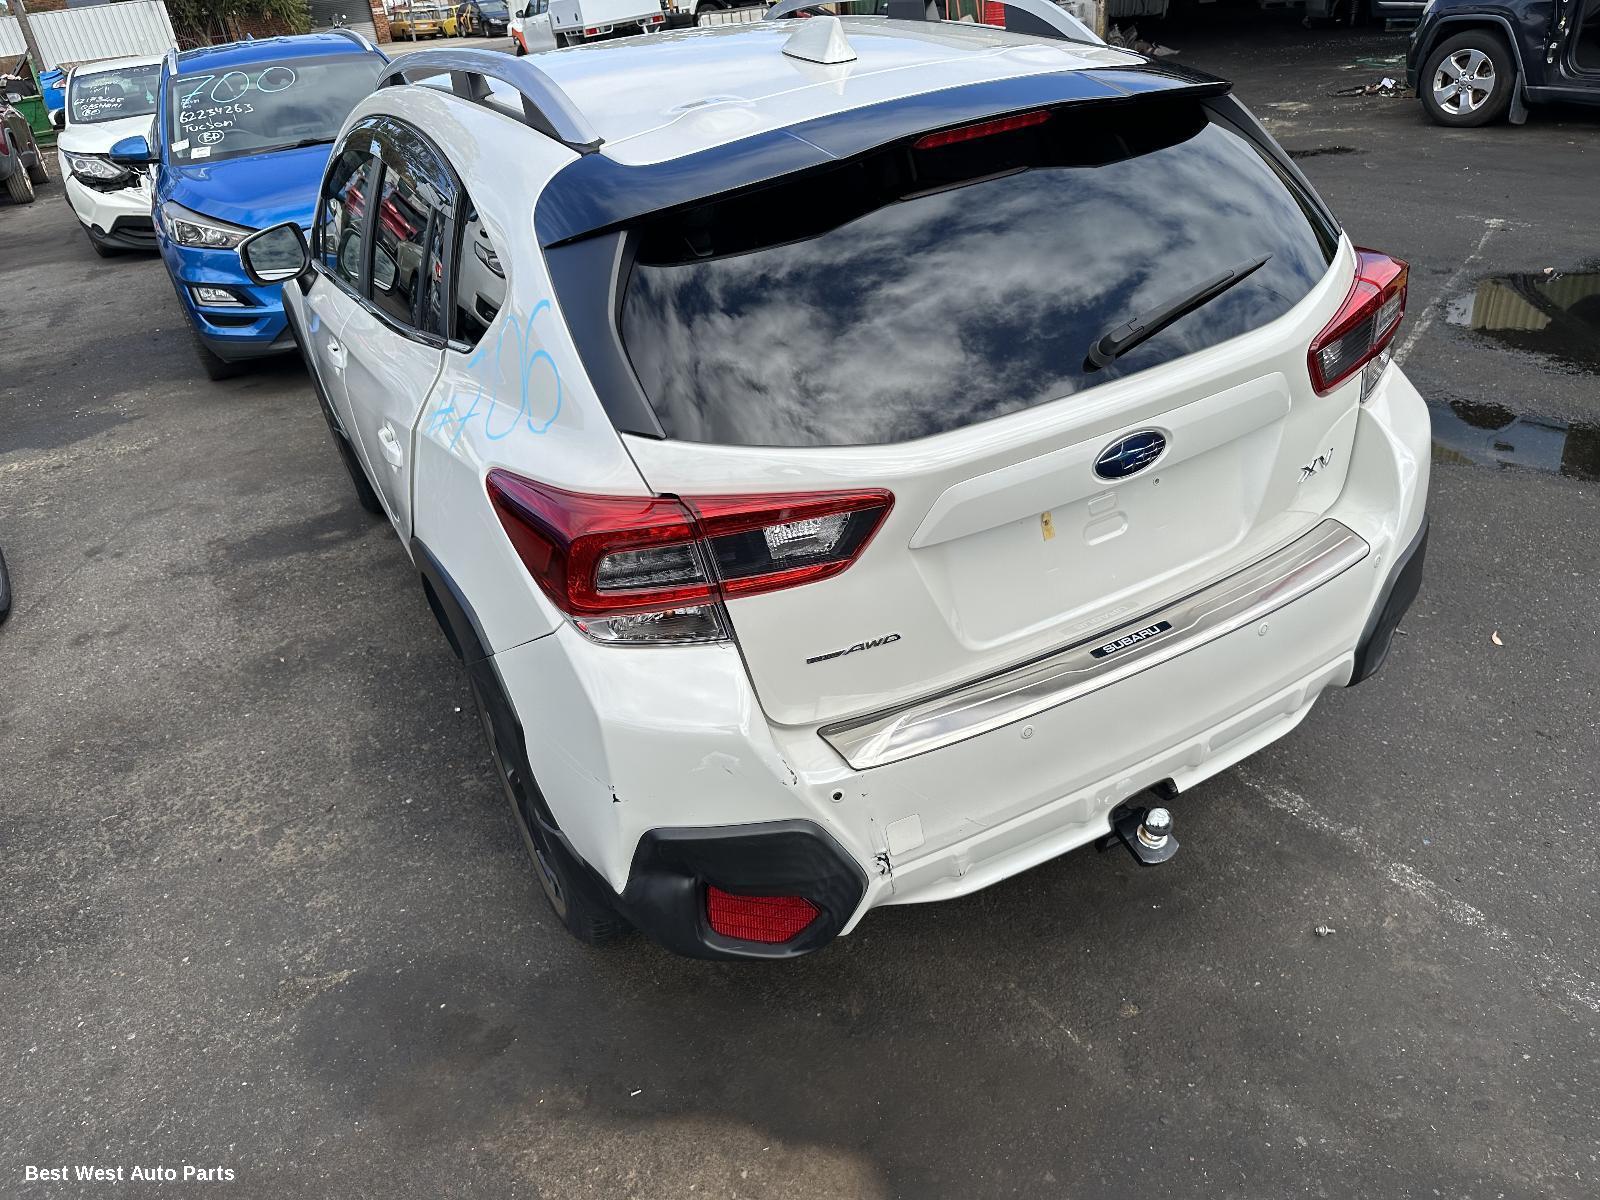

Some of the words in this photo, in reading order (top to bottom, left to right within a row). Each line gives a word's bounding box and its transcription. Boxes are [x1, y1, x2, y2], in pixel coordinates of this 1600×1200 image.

[180, 103, 255, 123] 62234263
[1296, 447, 1334, 484] XV
[842, 633, 902, 656] AWD
[1102, 625, 1161, 654] SUBARU
